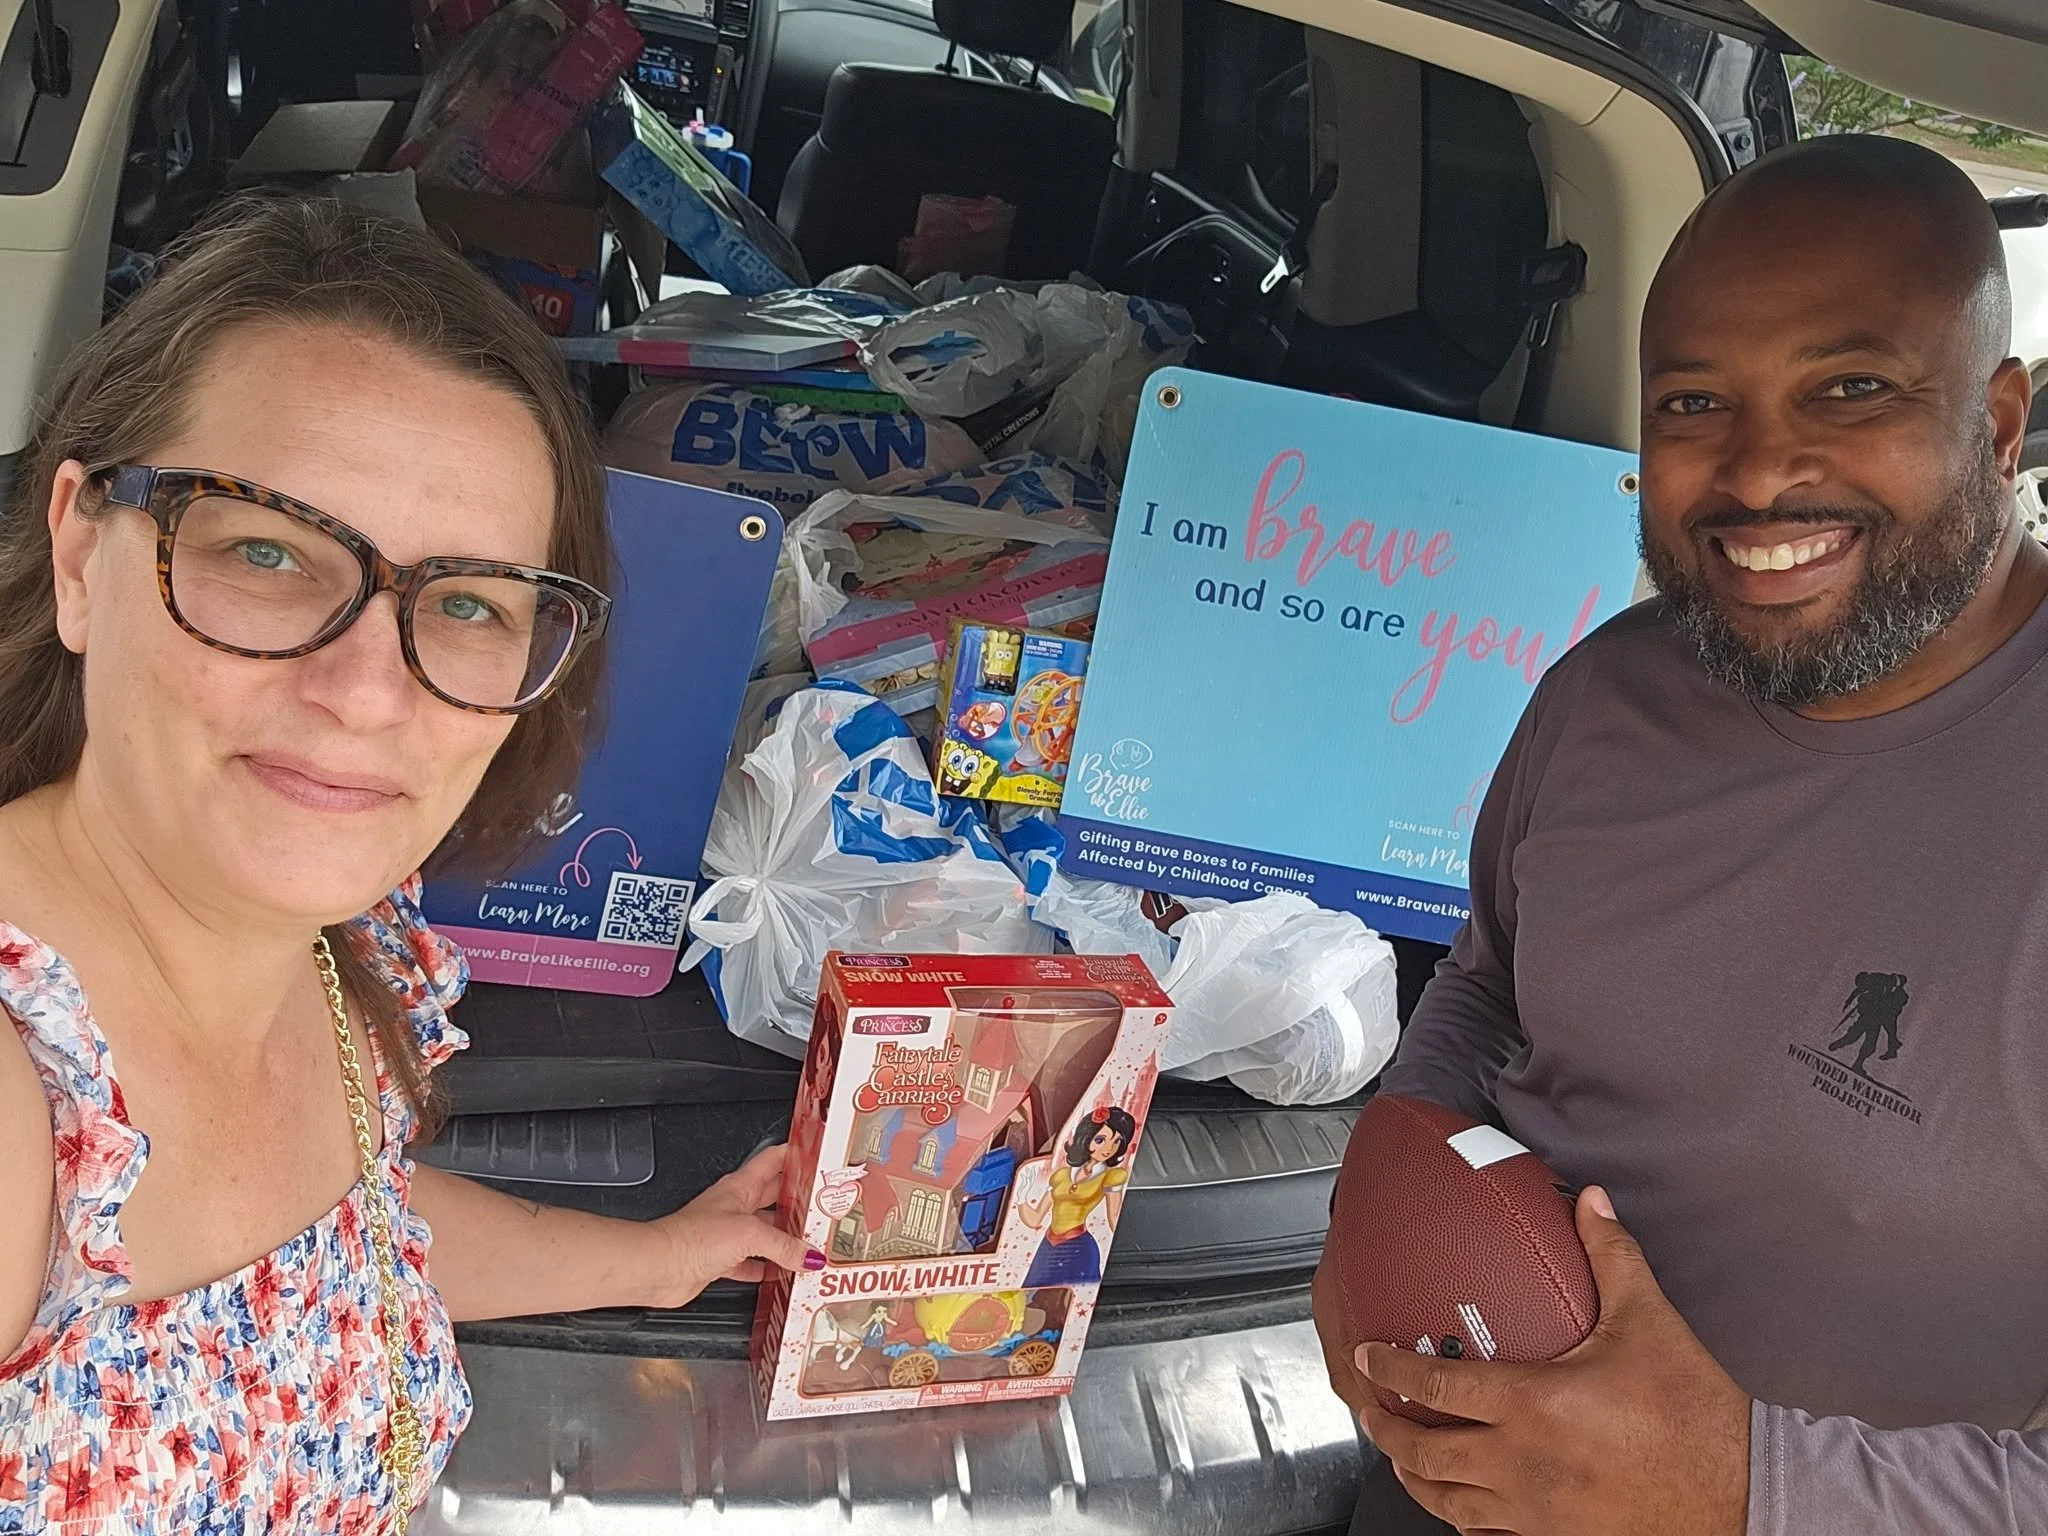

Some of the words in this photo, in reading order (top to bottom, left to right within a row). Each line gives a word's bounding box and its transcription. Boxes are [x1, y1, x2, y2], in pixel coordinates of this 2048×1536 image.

[1140, 502, 1158, 537] I
[1173, 518, 1227, 551] am
[1244, 449, 1457, 588] brave
[1194, 577, 1266, 612] and
[1280, 593, 1324, 622] so
[1341, 606, 1405, 638] are
[1390, 584, 1600, 724] you!
[1077, 752, 1153, 794] Brave
[1104, 788, 1149, 821] Ellie
[1388, 819, 1417, 832] SCAN
[1419, 826, 1443, 838] HERE
[1447, 831, 1460, 840] TO
[1078, 849, 1143, 871] Affected
[1147, 859, 1167, 878] by
[1170, 865, 1249, 890] Childhood
[1079, 830, 1131, 853] Gifting
[1135, 840, 1179, 859] Brave
[1183, 850, 1227, 869] Boxes
[1231, 858, 1247, 872] to
[1251, 862, 1315, 884] Families
[1381, 834, 1427, 869] Learn
[1430, 846, 1469, 878] Mor
[521, 883, 549, 894] HERE
[553, 887, 568, 896] TO
[1356, 889, 1471, 920] www.BraveLike
[478, 893, 532, 925] Learn
[535, 902, 591, 931] More
[844, 971, 904, 983] SNOW
[905, 971, 967, 983] WHITE
[845, 956, 904, 966] PRINCESS
[860, 1018, 924, 1033] PRINCESS
[873, 1037, 962, 1073] Fairytale
[869, 1061, 945, 1093] Castle
[1787, 1043, 1849, 1085] WOUNDED
[1852, 1078, 1922, 1125] WARRIOR
[852, 1082, 963, 1125] Carriage
[1811, 1075, 1876, 1117] PROJECT
[819, 1268, 908, 1297] SNOW
[914, 1263, 1001, 1290] WHITE
[941, 1384, 983, 1394] WARNING:
